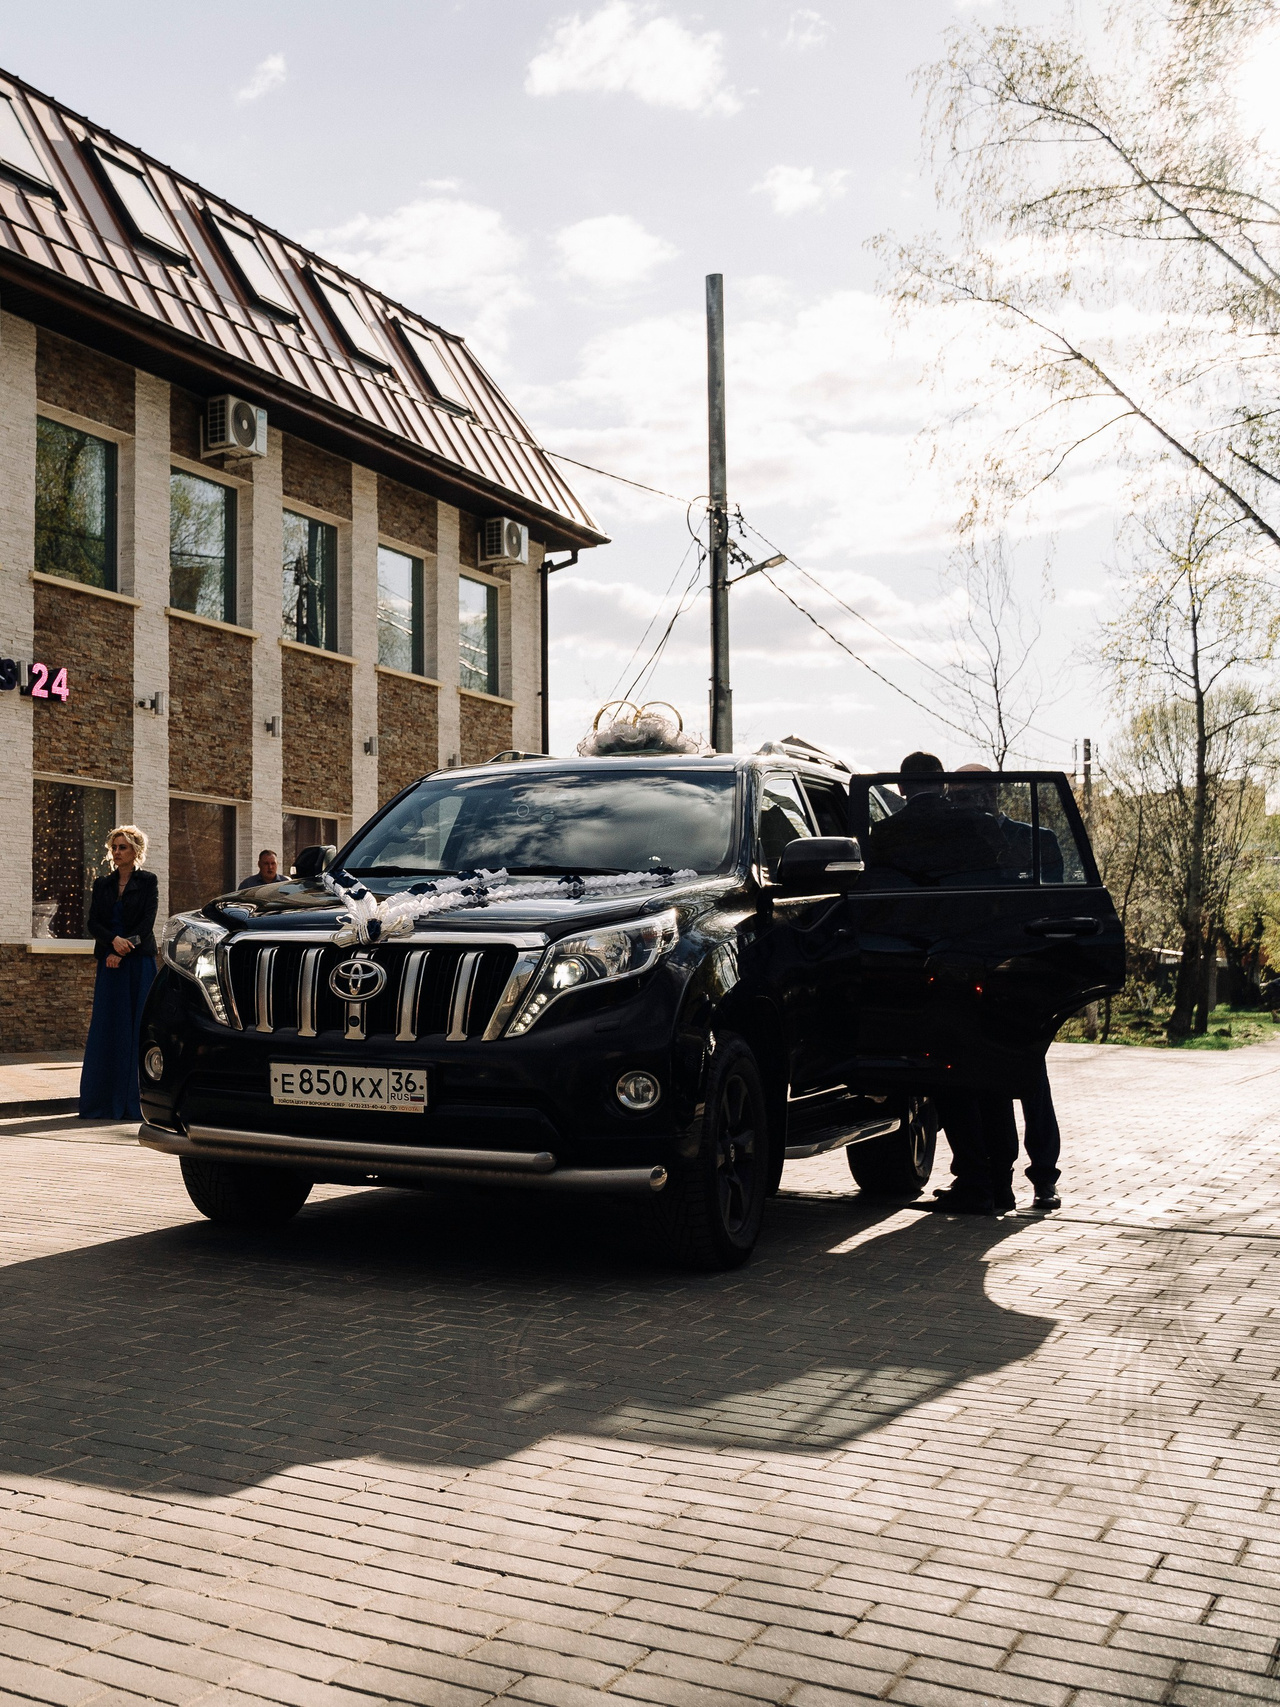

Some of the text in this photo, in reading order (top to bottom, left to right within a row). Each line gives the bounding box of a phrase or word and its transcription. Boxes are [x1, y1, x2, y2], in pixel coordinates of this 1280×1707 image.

[31, 662, 69, 702] 24
[281, 1068, 384, 1099] Е850КХ
[391, 1071, 418, 1093] 36
[390, 1093, 410, 1101] RUS
